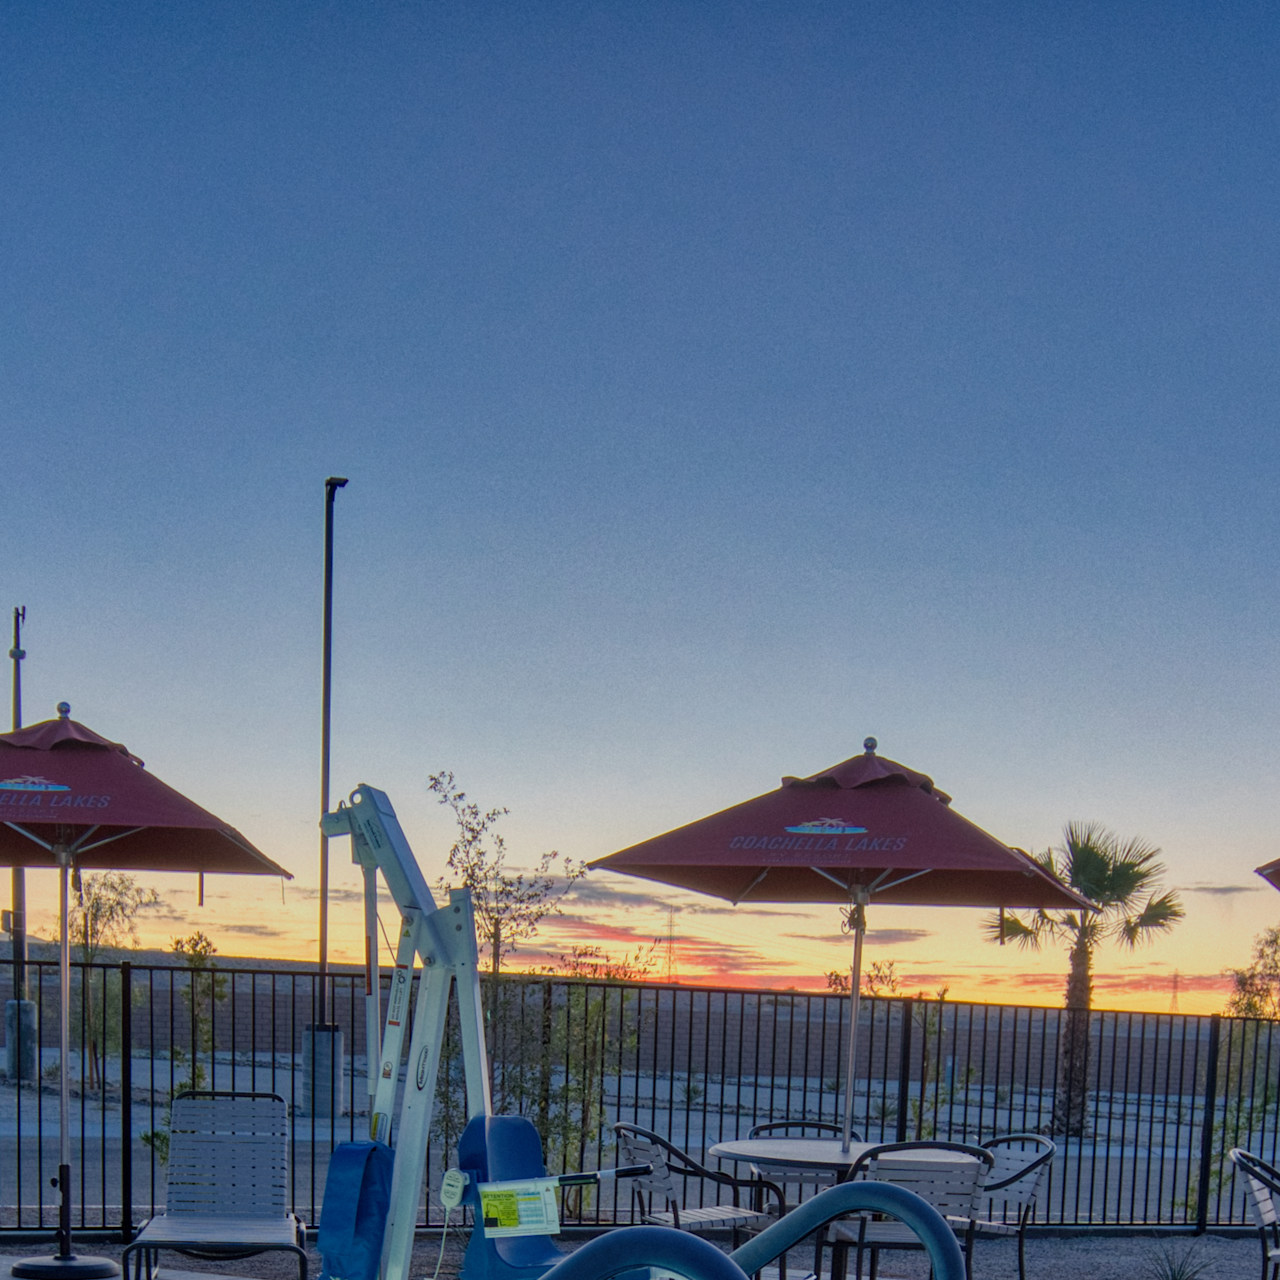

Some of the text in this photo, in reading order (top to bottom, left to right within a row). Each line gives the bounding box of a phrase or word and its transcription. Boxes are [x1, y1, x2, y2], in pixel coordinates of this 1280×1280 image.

[50, 795, 111, 808] LAKES
[729, 836, 908, 851] COACHELLA LAKES
